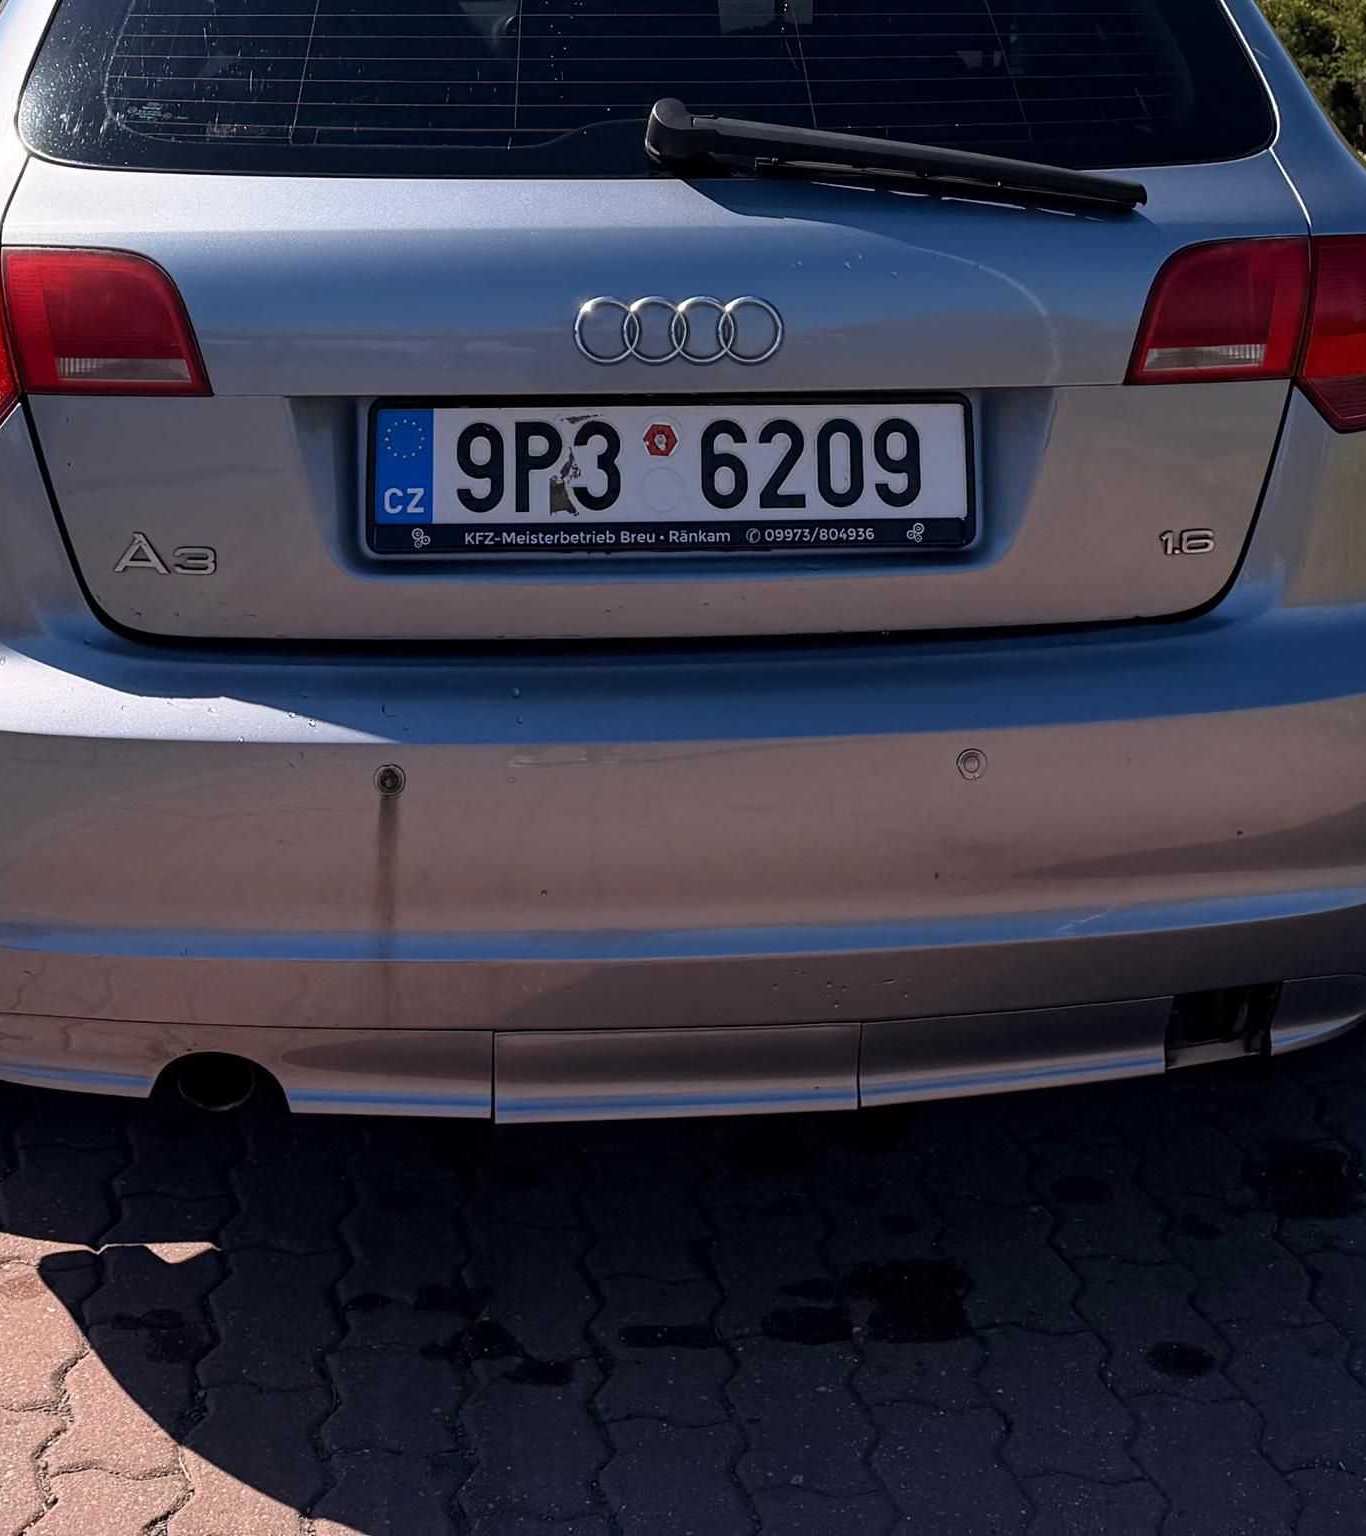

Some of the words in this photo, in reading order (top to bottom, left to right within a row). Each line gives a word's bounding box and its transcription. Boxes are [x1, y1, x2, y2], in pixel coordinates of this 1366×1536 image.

[456, 420, 621, 513] 9P3
[700, 418, 922, 510] 6209
[384, 488, 425, 514] CZ
[114, 531, 217, 576] A3
[464, 530, 616, 545] KFZ-Meisterbetrieb
[620, 530, 656, 543] Breu
[668, 529, 731, 544] Ränkam
[764, 527, 875, 543] 09973/804936
